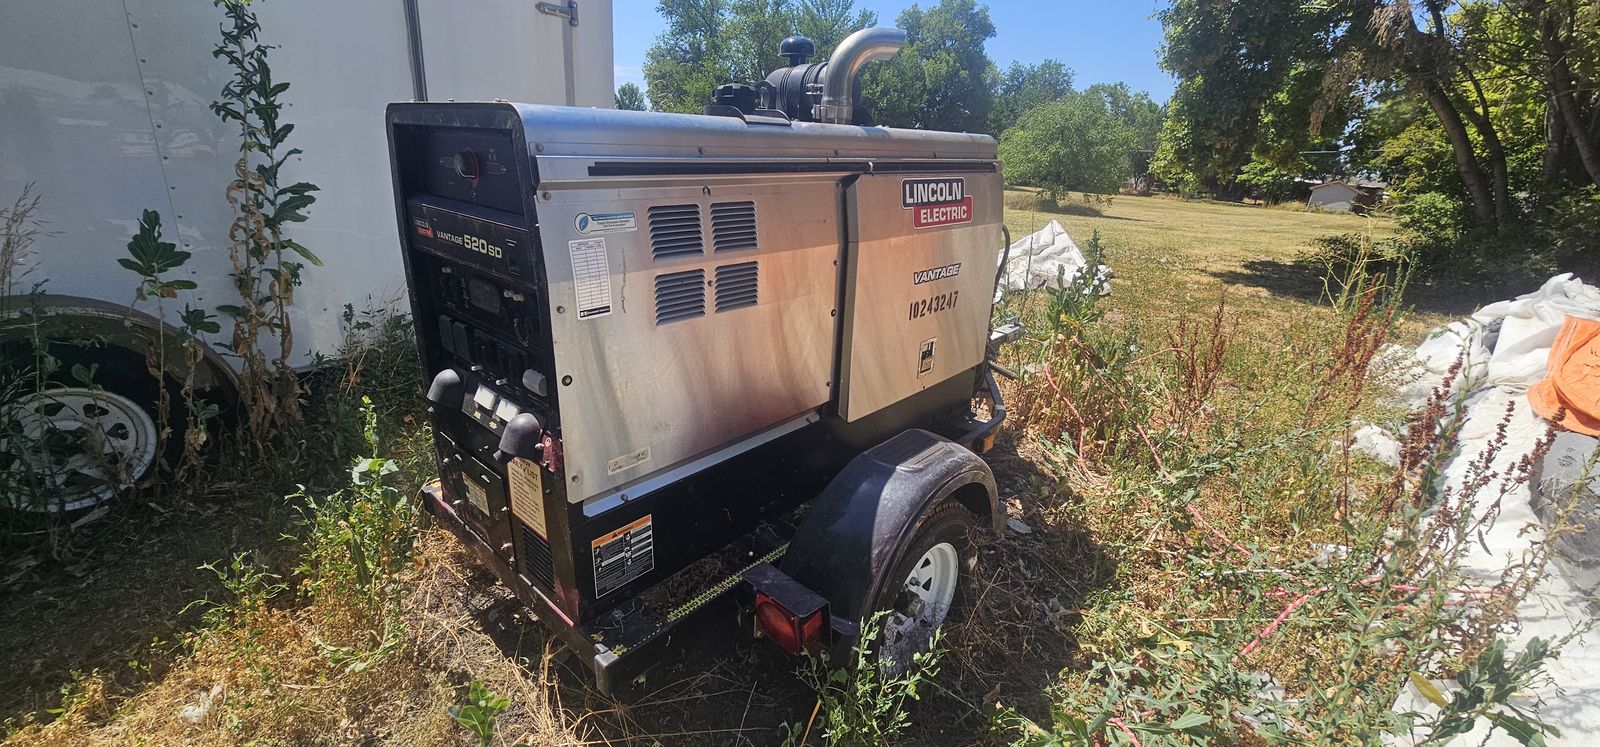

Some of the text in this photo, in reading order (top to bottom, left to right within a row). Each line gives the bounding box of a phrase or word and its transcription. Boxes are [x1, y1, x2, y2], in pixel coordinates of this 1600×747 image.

[905, 182, 962, 204] LINCOLN
[920, 205, 967, 224] ELECTRIC
[436, 229, 463, 245] VANTAGE
[463, 234, 487, 254] 520
[488, 245, 502, 258] SD
[913, 262, 961, 285] VANTAGE
[909, 290, 959, 321] 10243247
